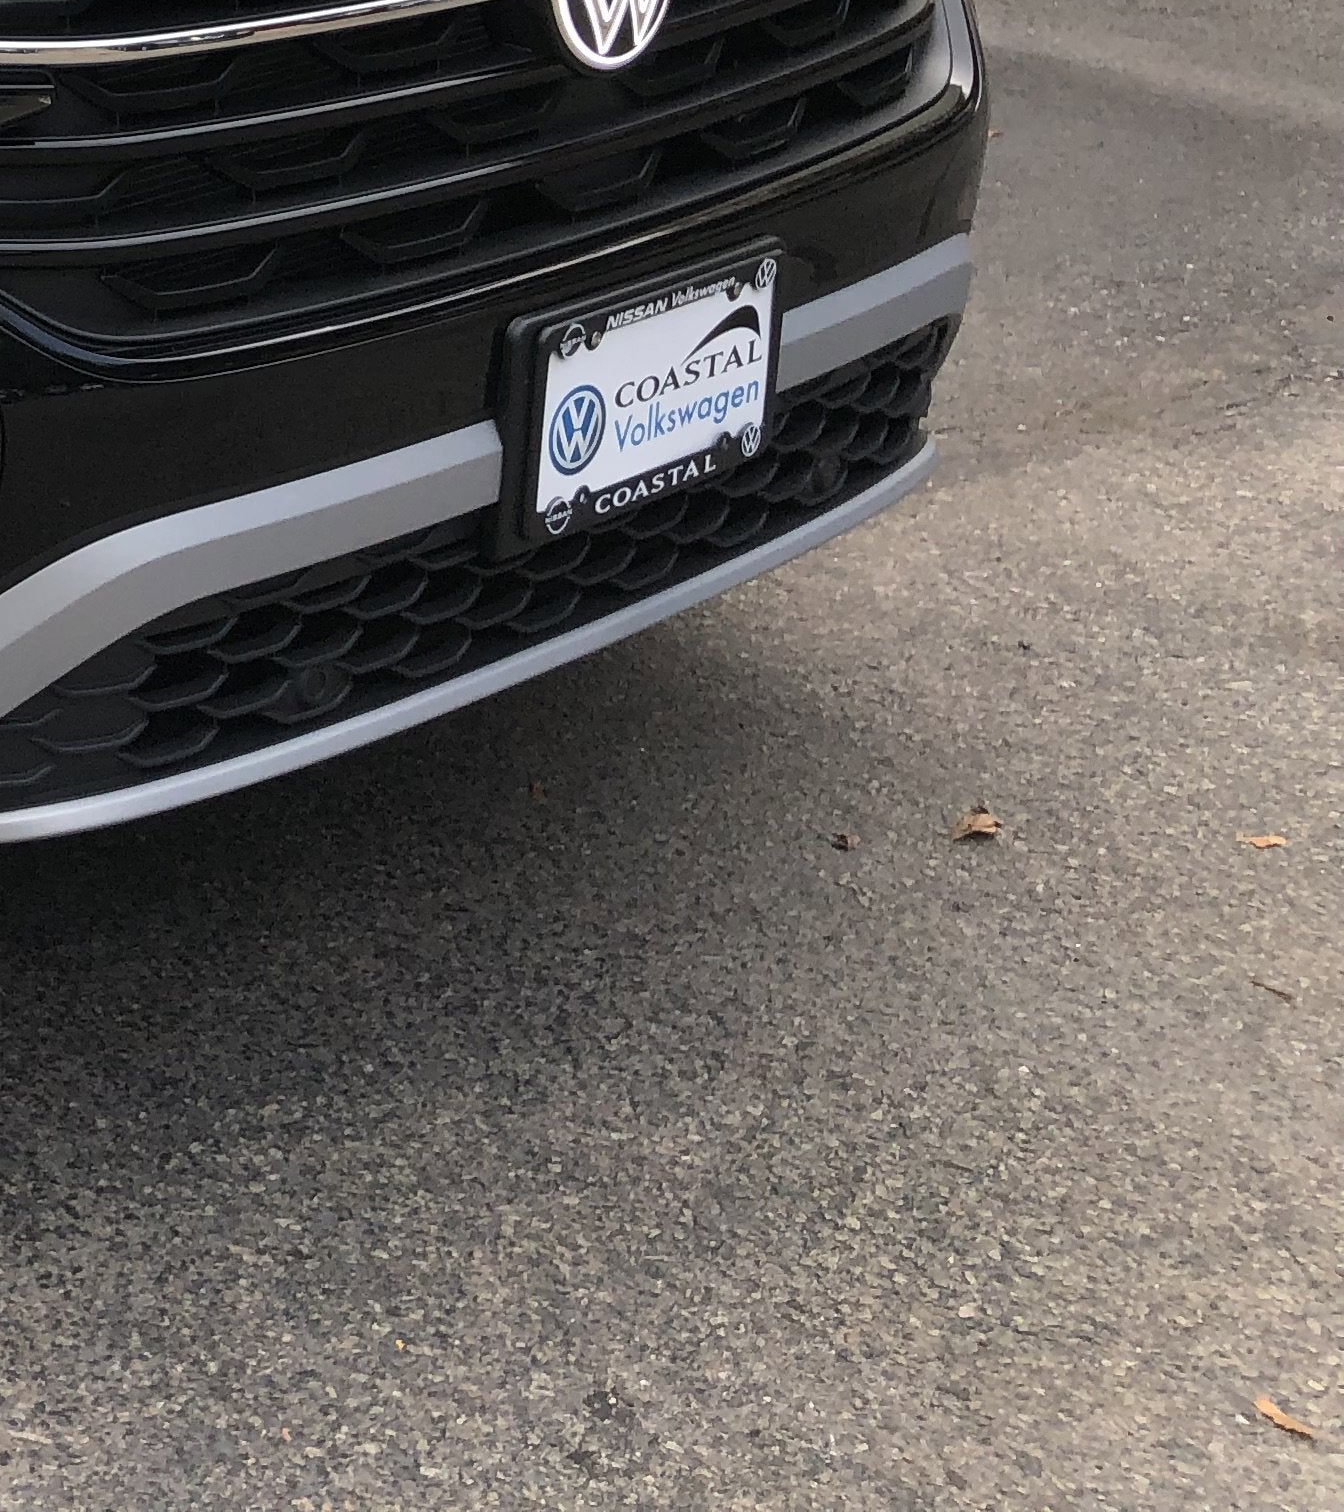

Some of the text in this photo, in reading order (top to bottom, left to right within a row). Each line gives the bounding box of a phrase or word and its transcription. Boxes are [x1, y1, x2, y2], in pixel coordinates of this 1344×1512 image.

[606, 276, 736, 331] NISSAN Volkswagen
[615, 339, 763, 408] COASTAL
[614, 380, 760, 453] Volkswagen
[594, 454, 716, 514] COASTAL
